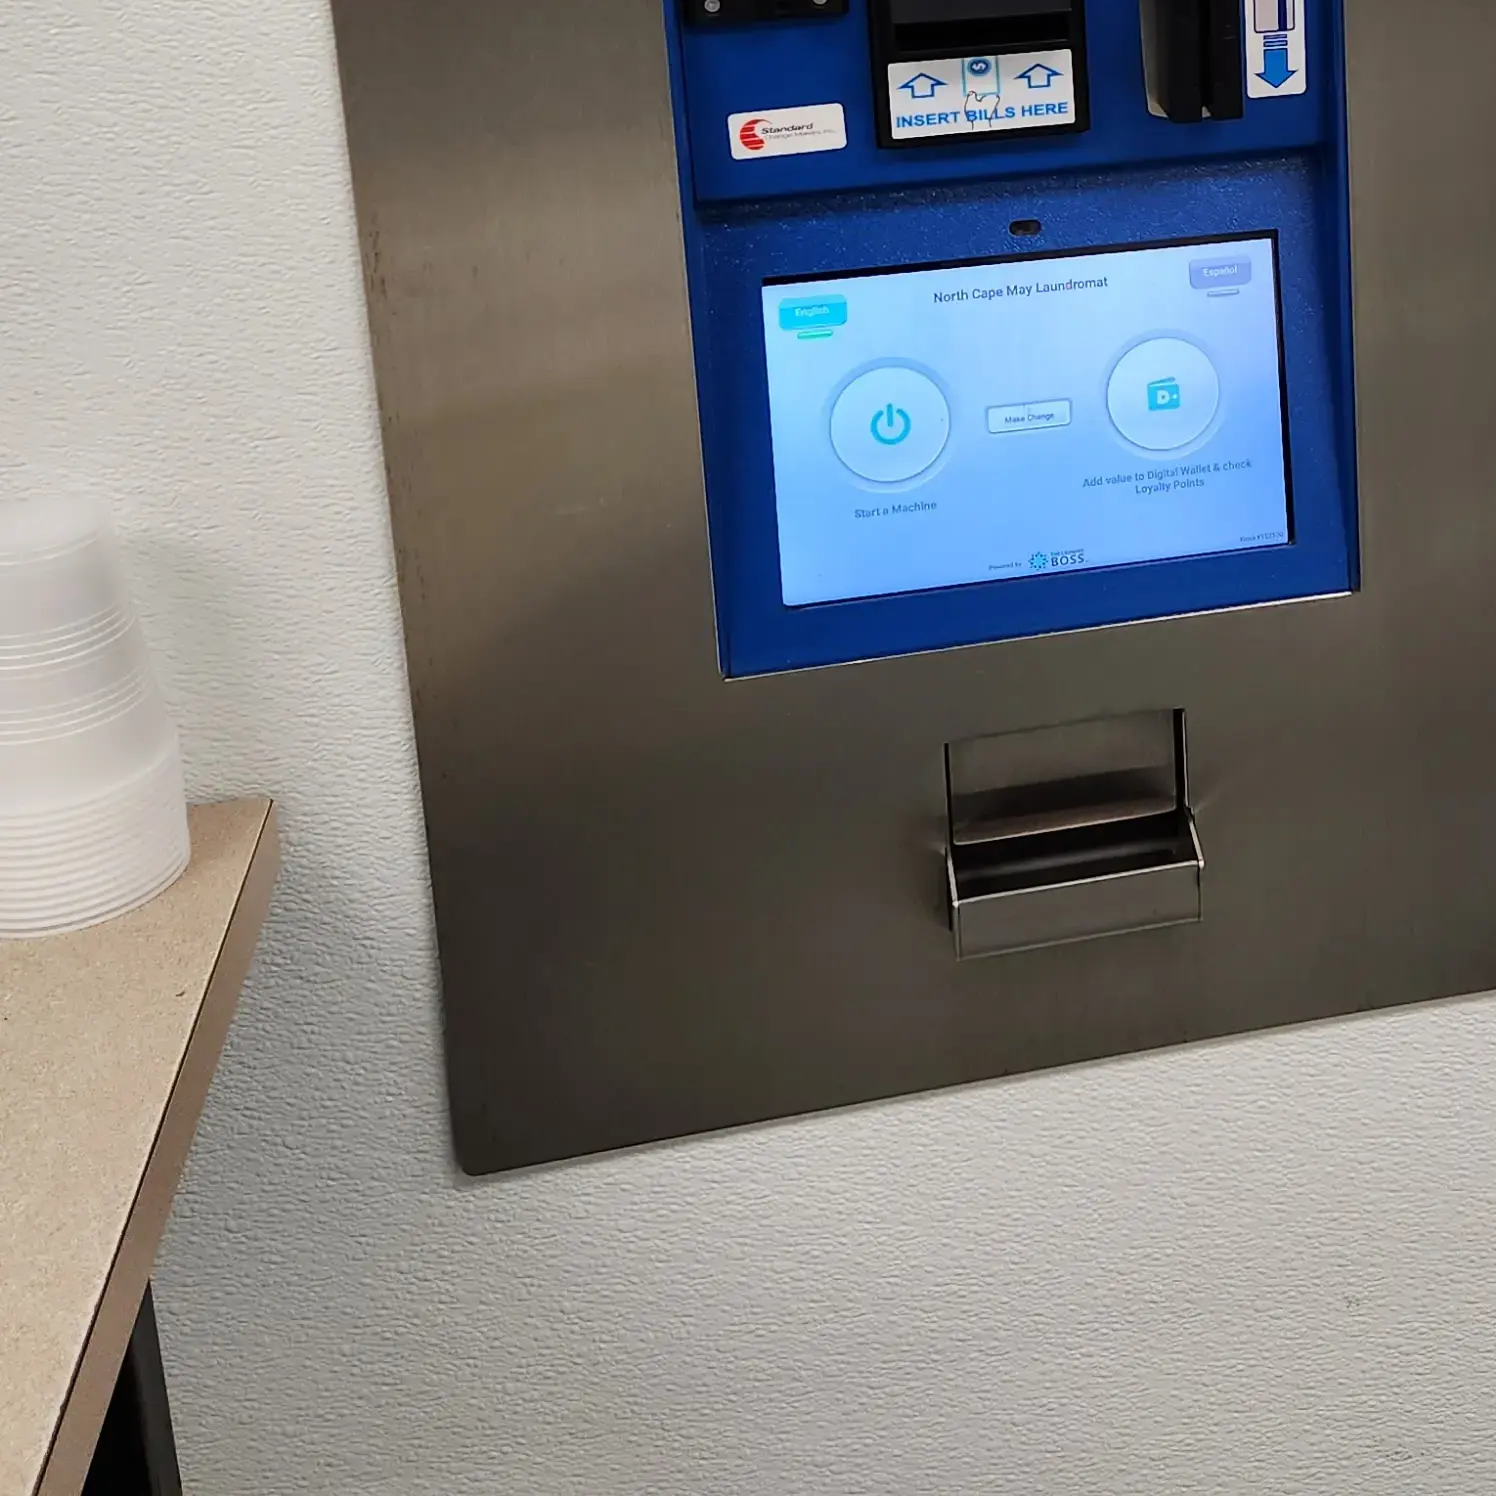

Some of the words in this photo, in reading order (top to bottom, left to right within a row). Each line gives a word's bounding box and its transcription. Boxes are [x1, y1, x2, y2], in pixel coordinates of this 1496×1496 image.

[896, 111, 960, 128] INSERT
[966, 106, 1015, 122] BILLS
[1021, 101, 1068, 117] HERE
[761, 123, 813, 134] Standard
[1202, 265, 1238, 277] Español
[934, 288, 968, 303] North
[972, 286, 1003, 301] Cape
[1006, 284, 1032, 298] May
[1036, 277, 1108, 293] Laundromat
[795, 305, 829, 317] English
[1005, 416, 1025, 424] Make
[1028, 413, 1054, 422] Change
[1082, 477, 1103, 488] Add
[1106, 475, 1132, 484] value
[1135, 472, 1144, 481] to
[1147, 467, 1178, 480] Digital
[1181, 464, 1211, 475] Wallet
[1213, 463, 1221, 471] &
[1135, 482, 1171, 495] Loyalty
[1174, 478, 1205, 489] Points
[854, 508, 880, 518] Start
[892, 501, 937, 514] Machine
[1051, 554, 1084, 566] BOSS
